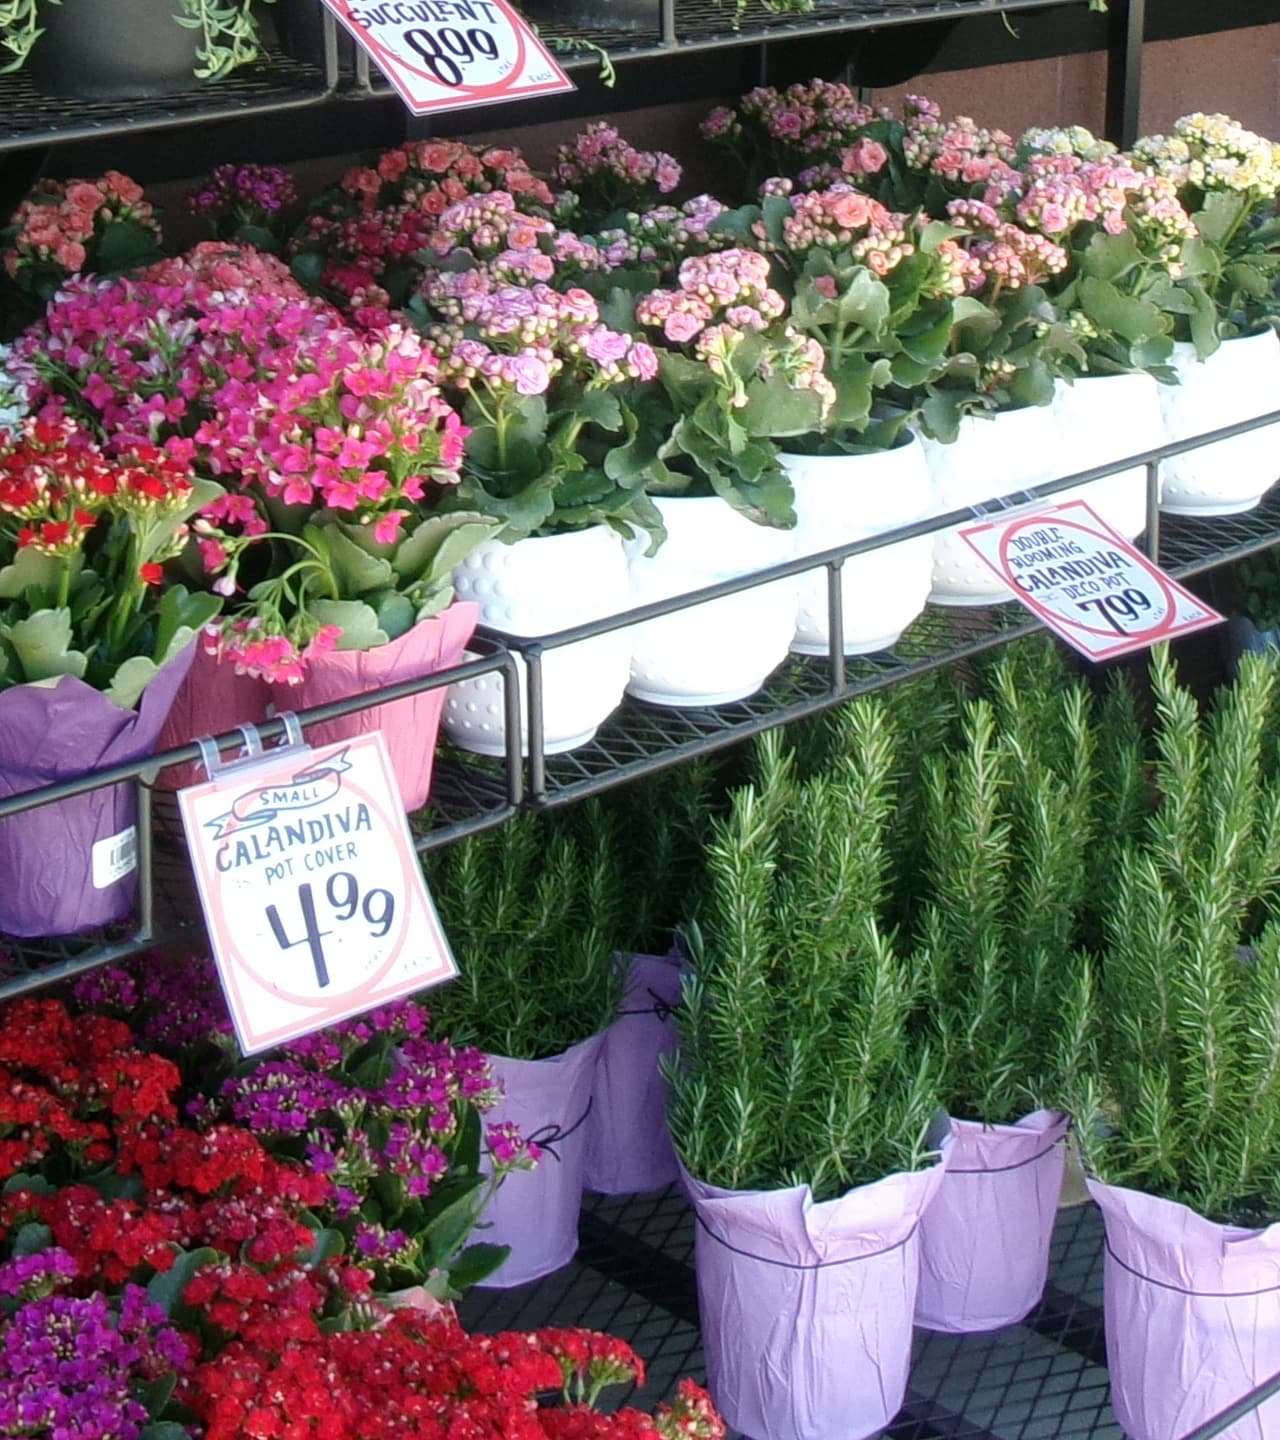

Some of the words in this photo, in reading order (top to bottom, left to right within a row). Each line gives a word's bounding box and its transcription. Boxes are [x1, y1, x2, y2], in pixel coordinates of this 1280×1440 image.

[1008, 527, 1064, 552] DOUBLE
[1008, 541, 1084, 568] BLOOMING
[1014, 550, 1132, 593] CALANDIVA
[1061, 580, 1099, 600] DECO
[1103, 572, 1134, 590] POT
[259, 786, 319, 805] SMALL
[215, 803, 373, 873] CALANDIVA
[264, 856, 295, 885] POT
[304, 842, 358, 872] COVER
